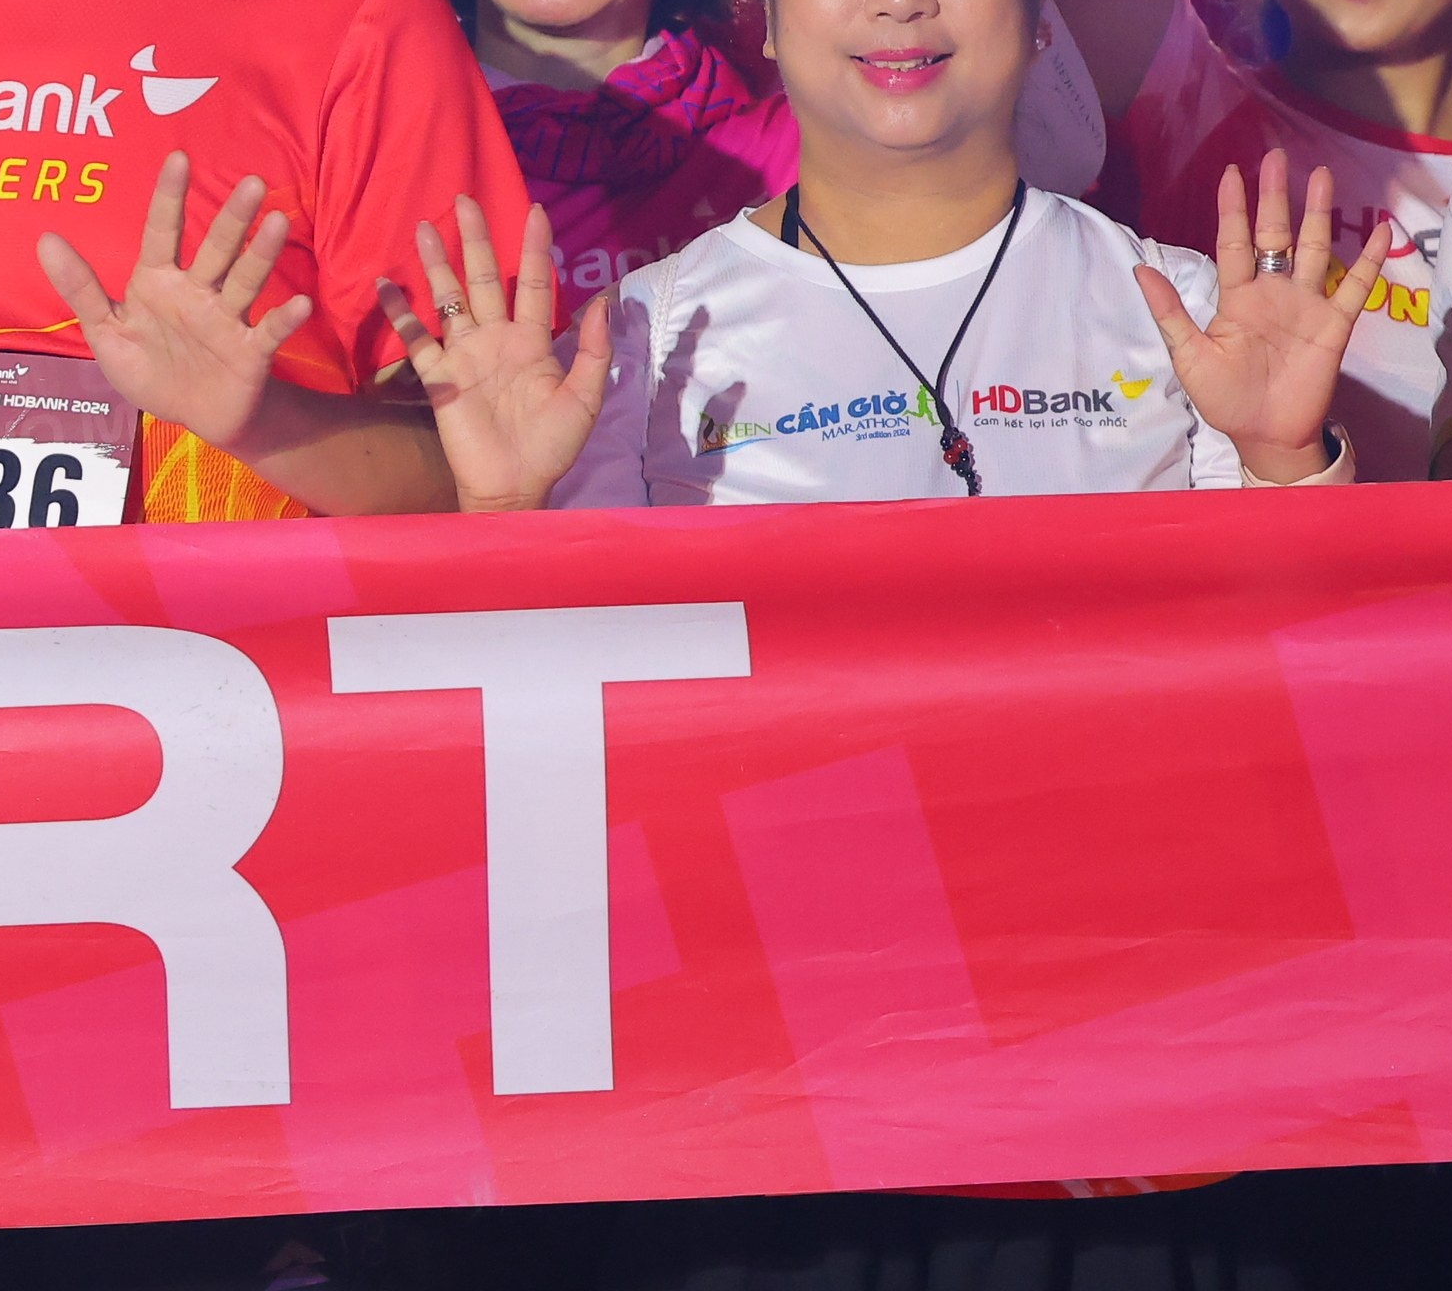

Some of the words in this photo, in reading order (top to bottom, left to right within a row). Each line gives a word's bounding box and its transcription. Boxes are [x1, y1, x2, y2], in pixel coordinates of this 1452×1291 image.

[3, 393, 68, 412] HDBANK
[71, 399, 110, 416] 2024
[972, 384, 1114, 415] HDBank
[776, 401, 840, 435] CẦN
[848, 389, 907, 418] GIỜ
[1005, 417, 1023, 428] kết
[1099, 416, 1128, 428] nhất
[821, 416, 909, 441] MARATHON
[856, 431, 867, 441] 3rd
[893, 428, 910, 438] 2024
